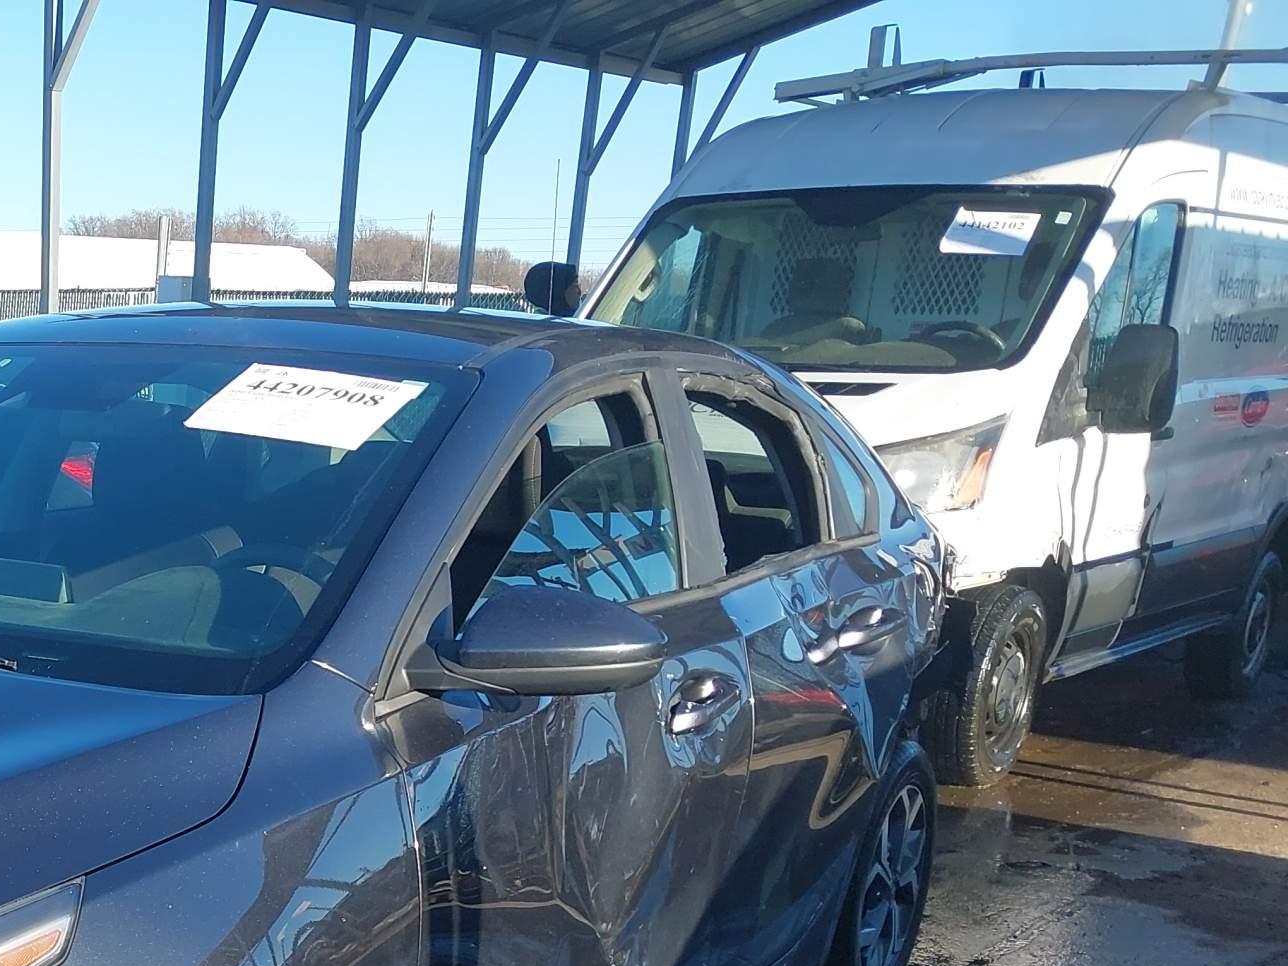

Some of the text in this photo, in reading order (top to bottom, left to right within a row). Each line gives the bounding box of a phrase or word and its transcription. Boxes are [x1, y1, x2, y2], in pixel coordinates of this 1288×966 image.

[1217, 268, 1260, 308] Heating
[1211, 314, 1280, 350] Refrigeration
[247, 379, 385, 407] 44207908
